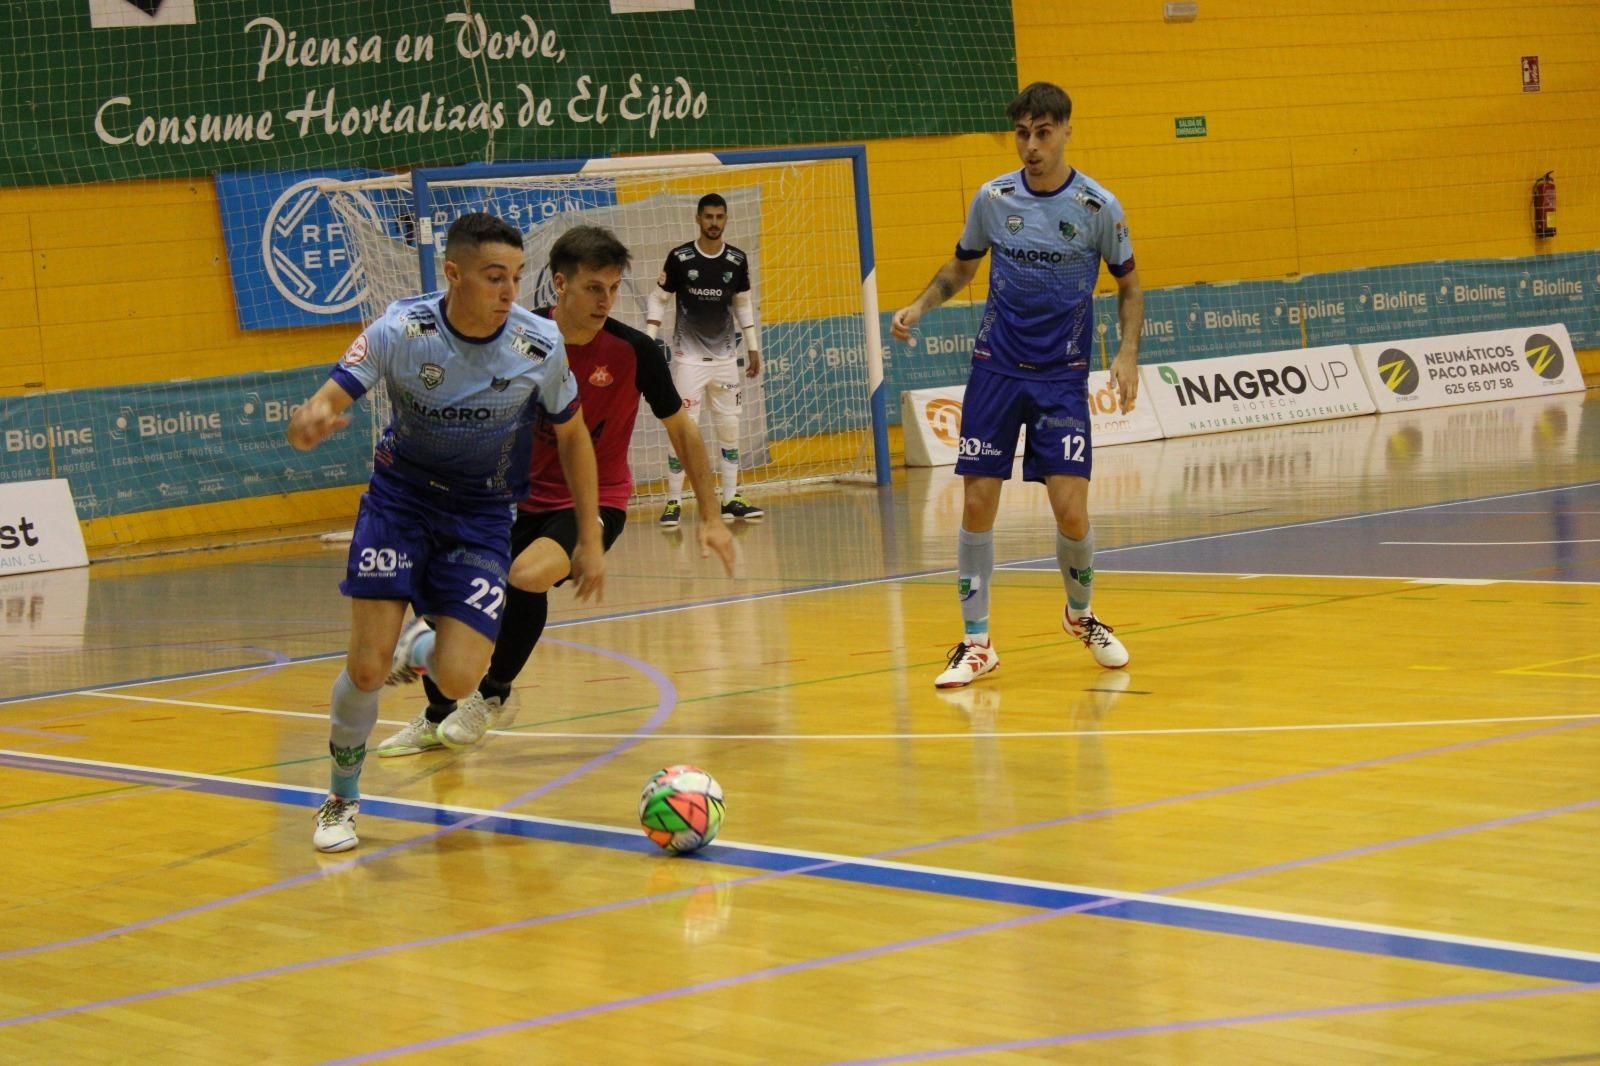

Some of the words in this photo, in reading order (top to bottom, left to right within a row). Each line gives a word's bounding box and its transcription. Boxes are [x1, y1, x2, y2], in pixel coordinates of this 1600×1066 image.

[244, 16, 382, 82] Piensa
[396, 32, 435, 63] en
[445, 12, 567, 64] Verde,
[94, 96, 274, 147] Consume
[286, 87, 505, 137] Hortalizas
[518, 84, 554, 127] de
[567, 75, 607, 125] El
[619, 73, 709, 139] Ejido
[302, 223, 345, 243] RF
[304, 248, 346, 269] EF
[1454, 284, 1506, 302] Bioline
[1533, 278, 1583, 296] Bioline
[1373, 291, 1427, 311] Bioline
[1204, 308, 1261, 329] Bioline
[1288, 300, 1345, 324] Bioline
[926, 335, 976, 355] Biolin
[1424, 346, 1514, 366] NEUMÁTICOS
[1428, 365, 1467, 381] PACO
[1471, 360, 1520, 377] RAMOS
[1445, 382, 1465, 395] 625
[1467, 381, 1481, 393] 65
[1483, 380, 1498, 391] 07
[1500, 378, 1514, 390] 58
[1233, 398, 1297, 412] BIOTECH
[138, 411, 221, 437] Bioline
[1190, 412, 1283, 431] NATURALMENTE
[1290, 403, 1360, 419] SOSTENIBLE
[5, 425, 93, 452] Bioline
[1062, 434, 1085, 462] 12
[0, 517, 39, 549] st
[358, 548, 397, 572] 30
[464, 577, 505, 620] 22
